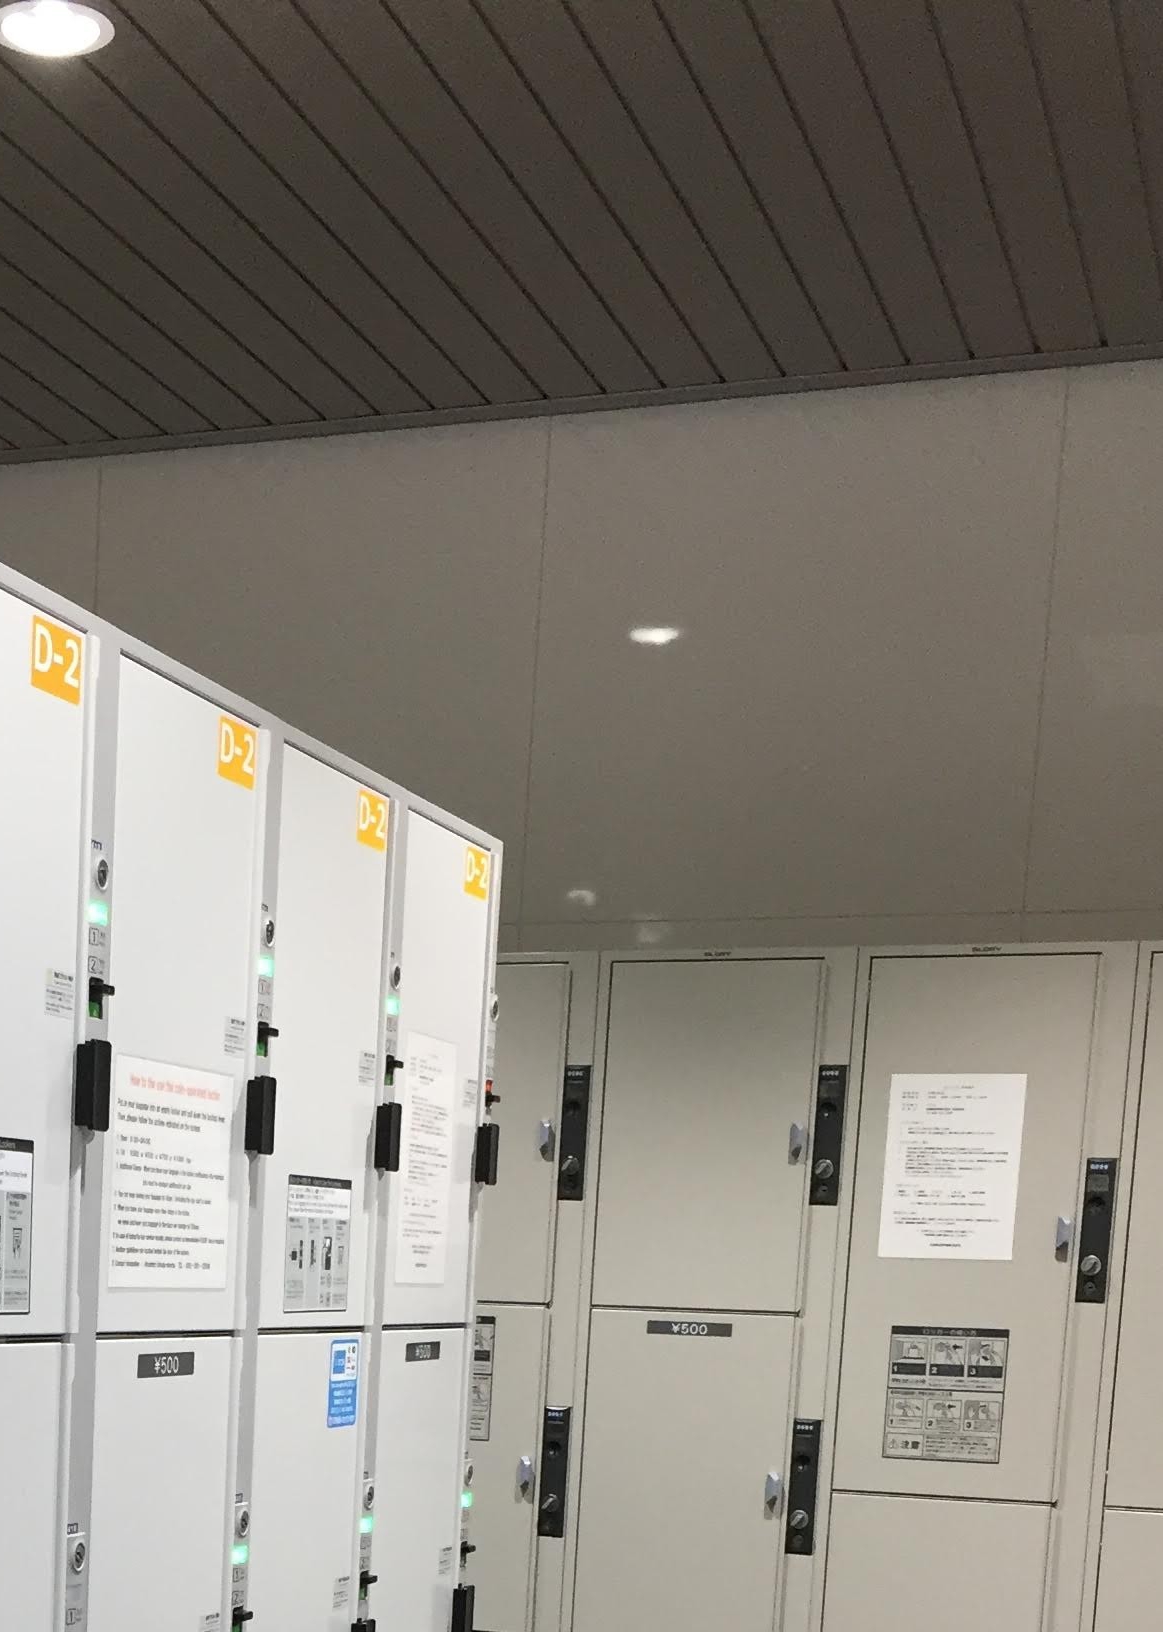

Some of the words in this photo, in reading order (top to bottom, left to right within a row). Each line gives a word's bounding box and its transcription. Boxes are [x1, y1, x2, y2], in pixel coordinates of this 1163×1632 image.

[34, 623, 80, 689] D-2
[220, 720, 254, 777] D-2
[359, 795, 386, 839] D-2
[467, 850, 487, 889] D-2
[672, 1322, 709, 1335] ¥500
[154, 1355, 180, 1375] ¥500
